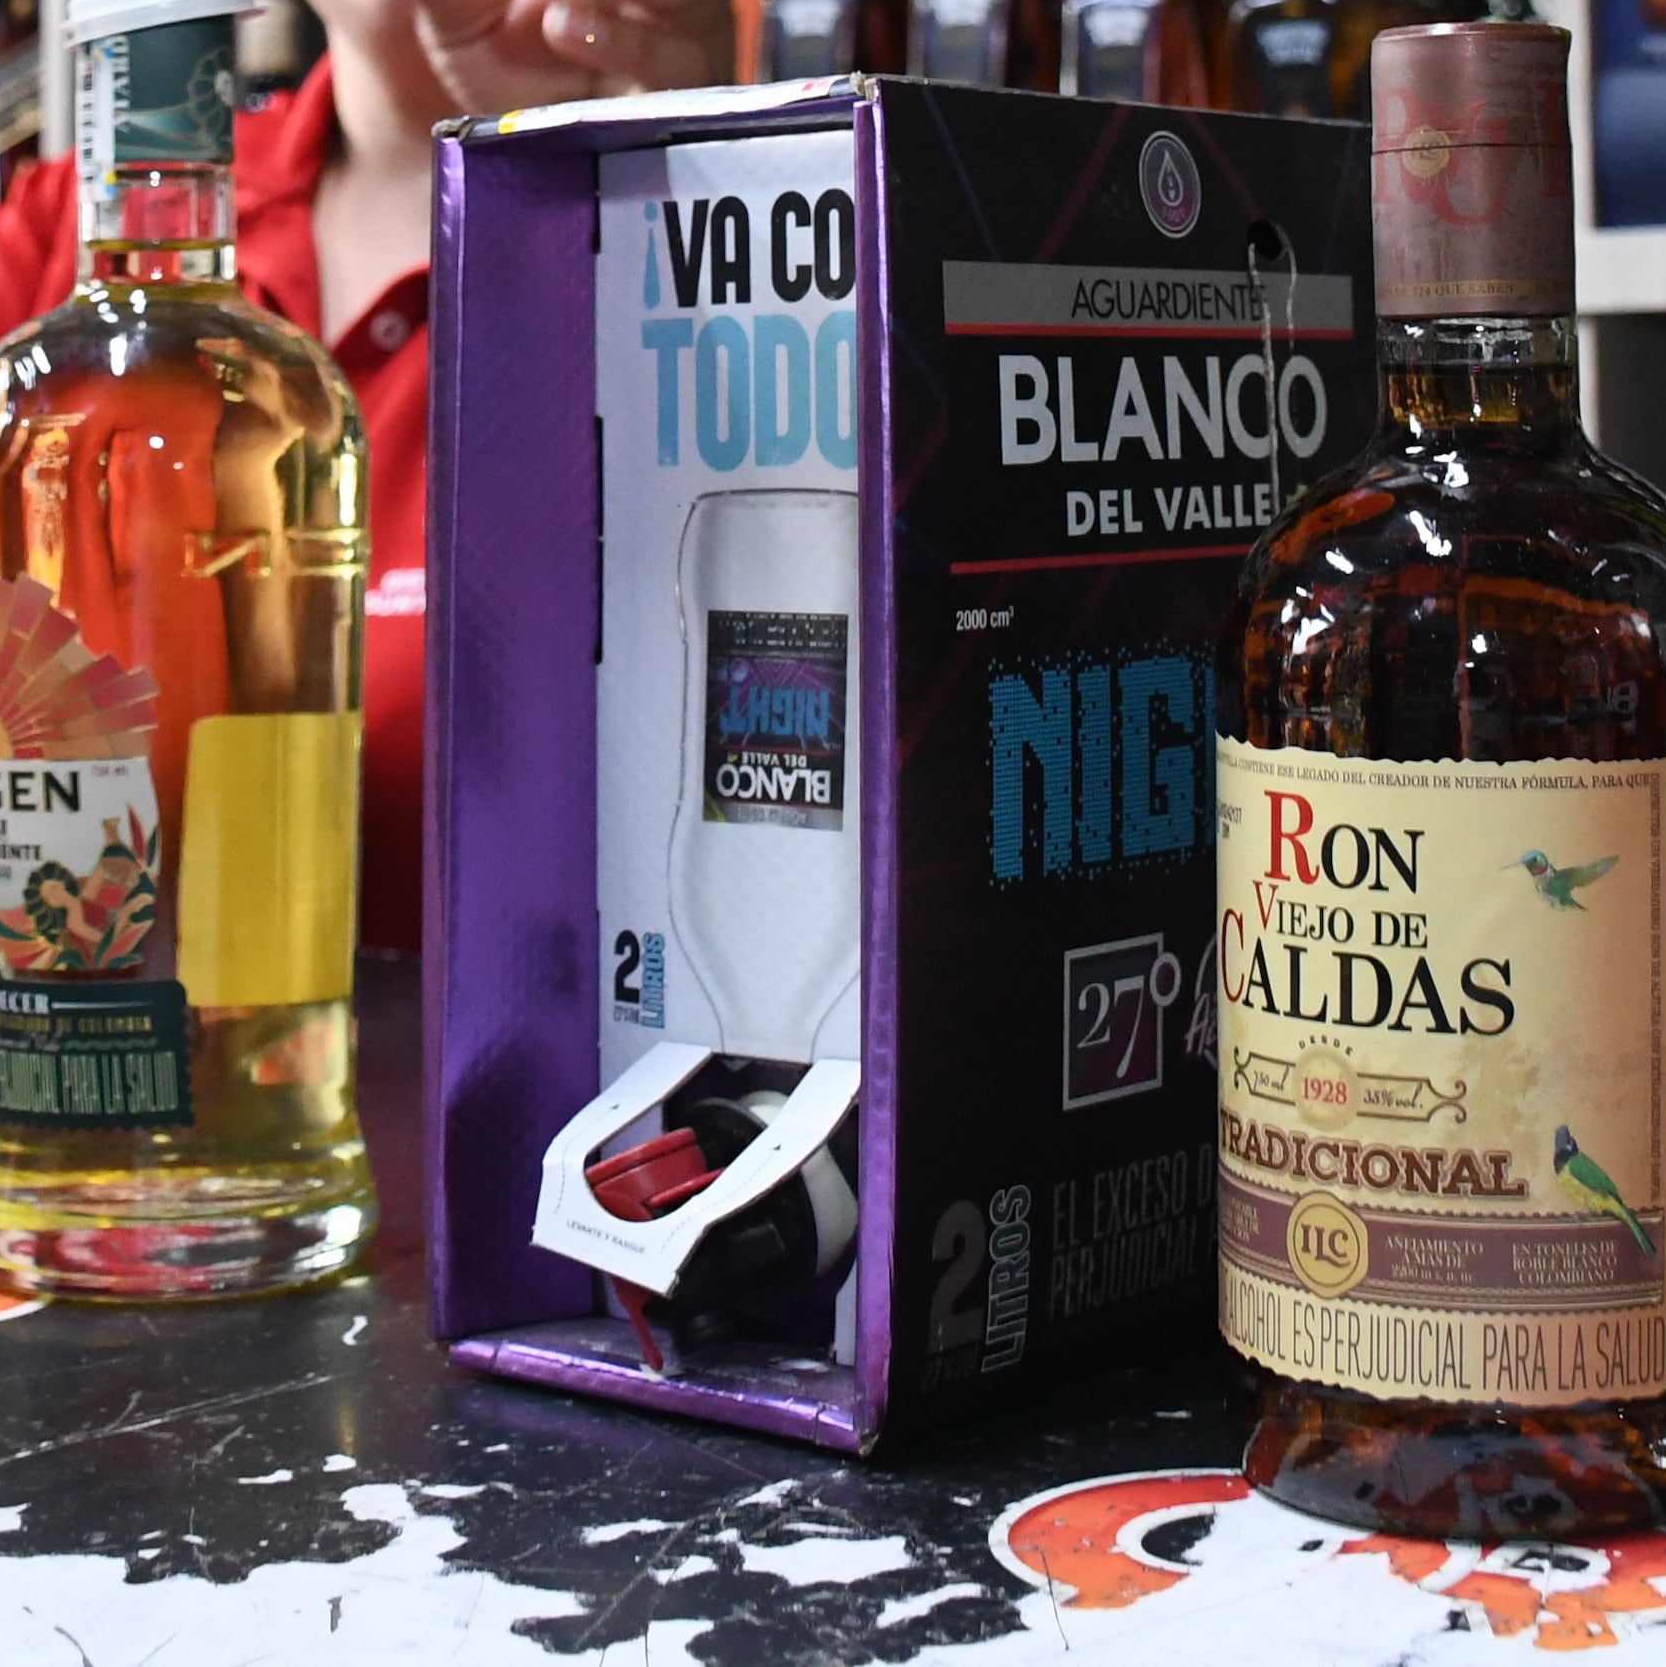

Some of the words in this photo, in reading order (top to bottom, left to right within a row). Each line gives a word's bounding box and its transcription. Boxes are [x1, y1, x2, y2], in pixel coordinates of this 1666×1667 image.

[644, 195, 751, 310] ¡VA
[1070, 278, 1270, 321] AGUARDIENTE
[641, 310, 858, 473] TODO
[998, 354, 1328, 466] BLANCO
[1065, 489, 1142, 537] DEL
[1154, 483, 1273, 533] VALLE
[955, 611, 988, 631] 2000
[718, 685, 831, 743] NIGHT
[716, 763, 831, 805] BLANCO
[989, 658, 1217, 881] NIG
[1276, 764, 1295, 778] ESE
[1296, 767, 1340, 783] LEGADO
[1342, 771, 1367, 785] DEL
[1368, 773, 1430, 788] CREADOR
[1433, 775, 1452, 789] DE
[1454, 776, 1518, 791] NUESTRA
[1521, 774, 1589, 790] FÓRMULA,
[1591, 774, 1624, 788] PARA
[1625, 773, 1650, 791] QUE
[1373, 911, 1429, 949] DE
[614, 929, 641, 1001] 2
[640, 931, 666, 1029] LITROS
[1220, 907, 1516, 1036] CALDAS
[1298, 1035, 1354, 1057] DESDE
[1302, 1076, 1348, 1106] 1928
[1363, 1088, 1394, 1108] 35%
[1395, 1081, 1424, 1109] vol.
[1220, 1108, 1530, 1198] TRADICIONAL
[1052, 1179, 1080, 1252] EL
[1093, 1150, 1188, 1240] EXCESO
[1049, 1212, 1197, 1322] PERJUDICIAL
[1300, 1222, 1351, 1268] ILC
[1445, 1255, 1467, 1270] DE
[1512, 1255, 1556, 1271] ROBLE
[1562, 1253, 1618, 1269] BLANCO
[1513, 1242, 1531, 1256] EN
[1535, 1241, 1598, 1257] TONELES
[1599, 1239, 1617, 1254] DE
[927, 1199, 986, 1354] 2
[981, 1182, 1032, 1375] LITROS
[1518, 1268, 1615, 1285] COLOMBIANO
[1292, 1302, 1317, 1368] ES
[1319, 1309, 1472, 1392] PERJUDICIAL
[1482, 1322, 1549, 1392] PARA
[1558, 1323, 1588, 1392] LA
[1595, 1315, 1666, 1389] SALUD
